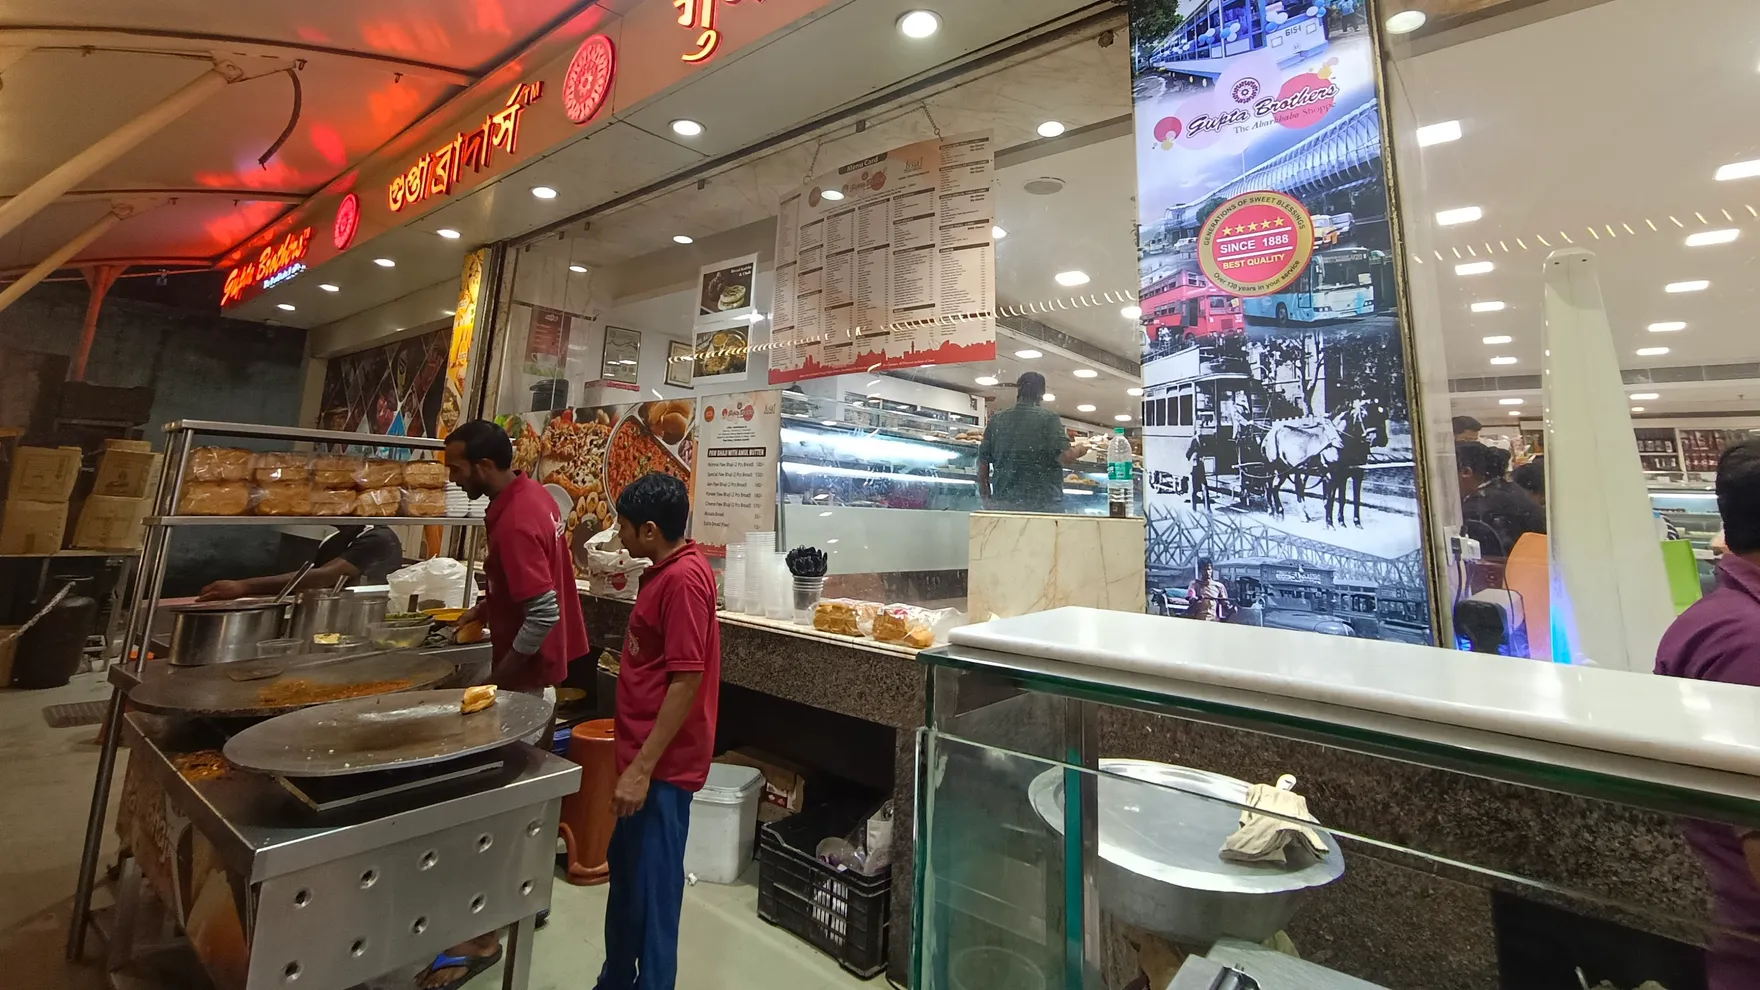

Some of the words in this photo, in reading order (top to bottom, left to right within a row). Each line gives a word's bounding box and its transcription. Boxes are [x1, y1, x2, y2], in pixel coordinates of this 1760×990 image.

[1187, 109, 1249, 138] Gupta
[1254, 84, 1338, 116] Brothers
[1233, 124, 1250, 135] The
[846, 162, 863, 172] Menu
[864, 155, 879, 167] Card
[1203, 204, 1238, 246] GENERATIONS
[1237, 199, 1248, 207] OF
[1249, 196, 1277, 204] SWEET
[1276, 199, 1306, 230] BLESSINGS
[1220, 240, 1256, 254] SINCE
[1262, 234, 1289, 247] 1888
[1222, 259, 1246, 270] BEST
[1247, 253, 1286, 266] QUALITY
[1213, 272, 1226, 284] Over
[1237, 284, 1257, 292] years
[1265, 279, 1281, 289] your
[1281, 260, 1300, 281] service
